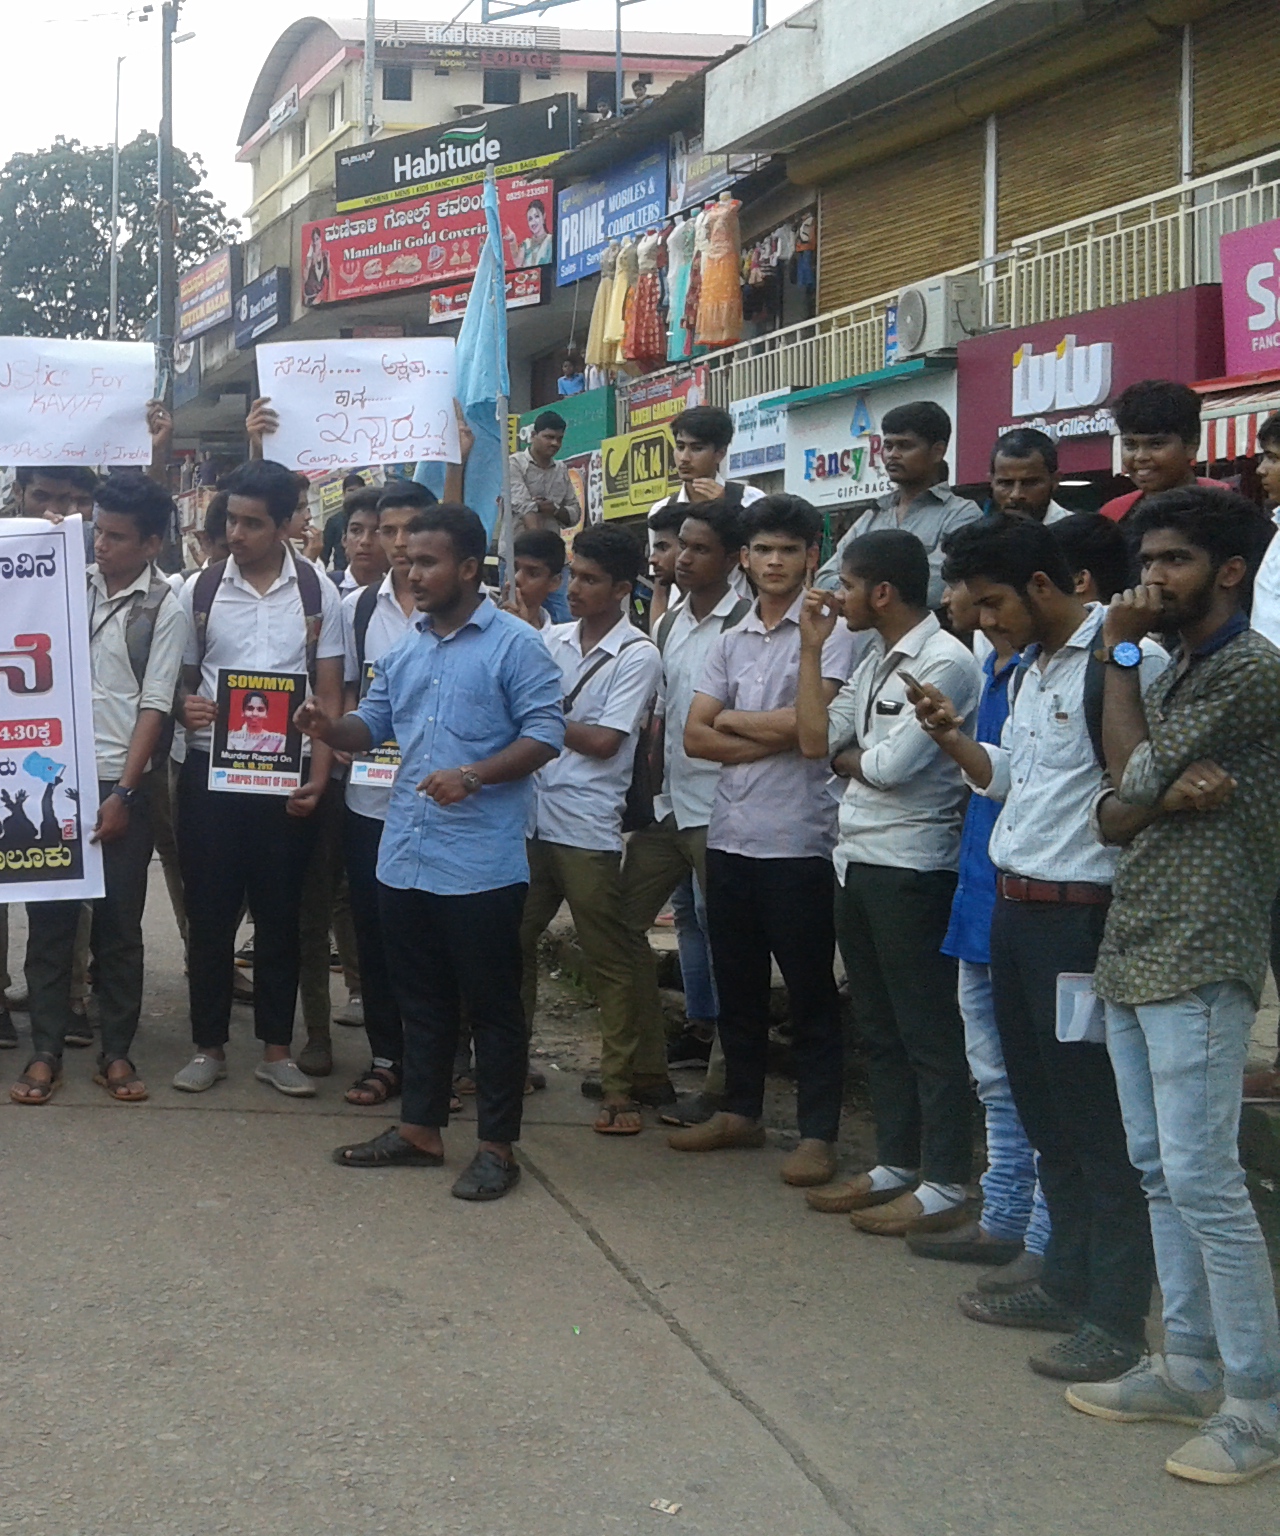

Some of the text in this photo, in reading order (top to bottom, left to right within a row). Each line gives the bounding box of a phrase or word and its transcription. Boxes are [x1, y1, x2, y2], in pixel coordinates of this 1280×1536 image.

[394, 137, 501, 183] Habitude
[608, 180, 646, 213] MOBILES
[561, 200, 605, 261] PRIME
[608, 201, 660, 238] COMPUTERS
[343, 223, 489, 260] Manithali Gold Coverin
[297, 450, 359, 466] Campus
[804, 447, 864, 481] Fancy
[227, 674, 296, 692] SOWMYA
[0, 722, 52, 747] 4.30ಕ್ಕೆ
[221, 751, 293, 764] Murder Raped On
[227, 773, 298, 788] CAMPUS FRONT OF INDIA
[367, 768, 393, 779] CAMPUS
